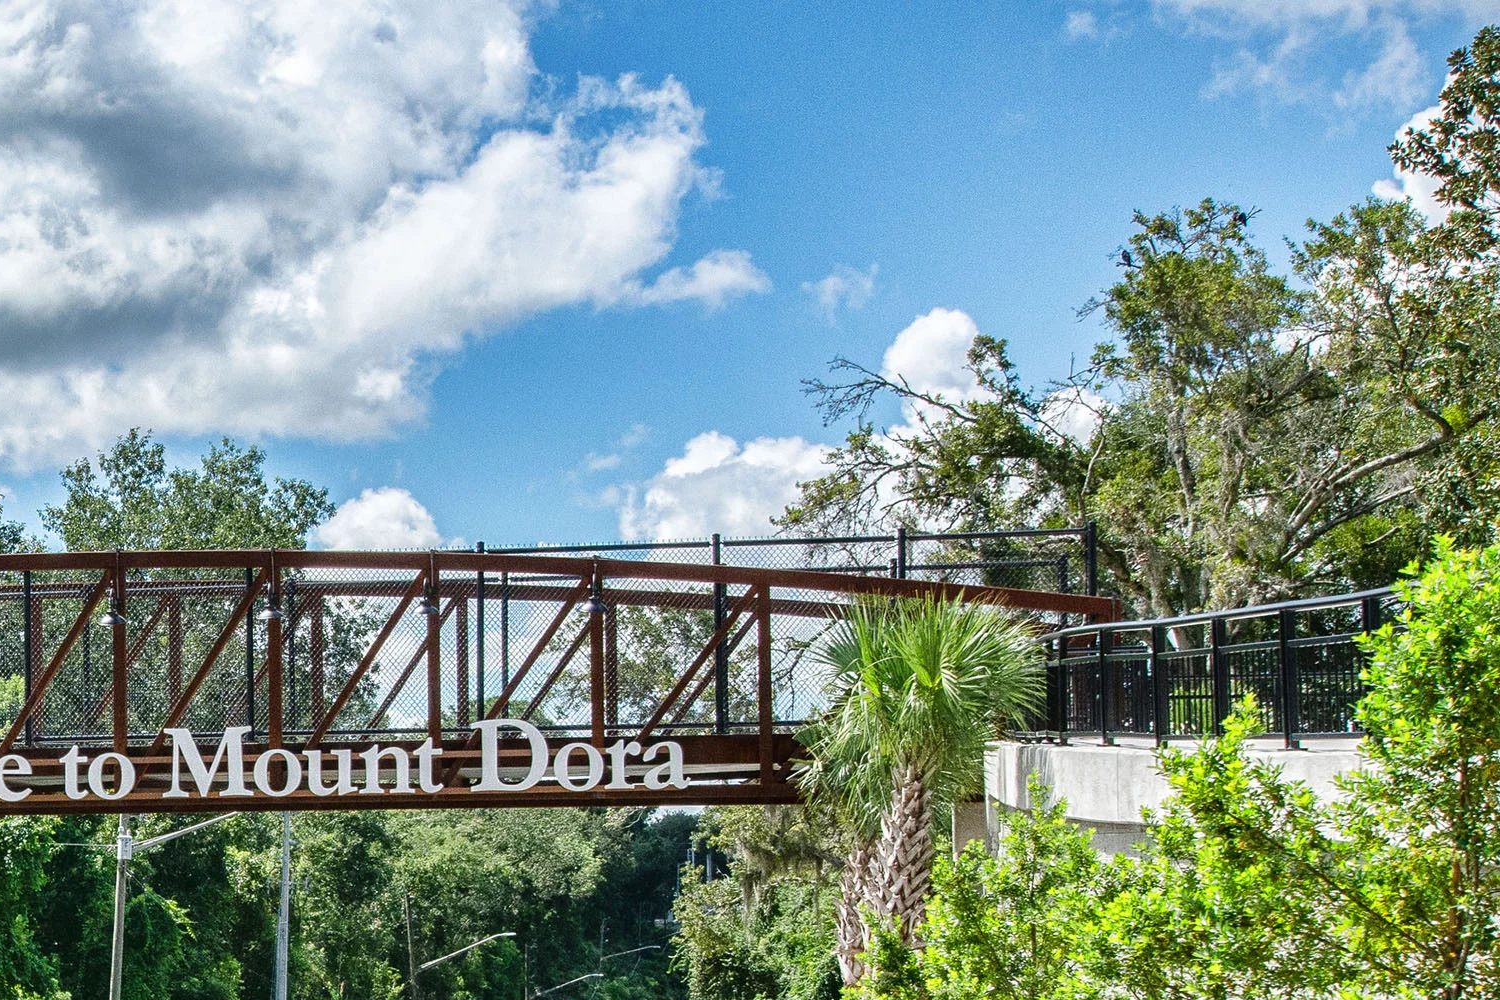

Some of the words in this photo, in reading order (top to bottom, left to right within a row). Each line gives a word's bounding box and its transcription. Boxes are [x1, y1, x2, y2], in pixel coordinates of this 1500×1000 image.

[59, 744, 136, 800] to
[162, 725, 444, 798] Mount
[470, 718, 692, 792] Dora
